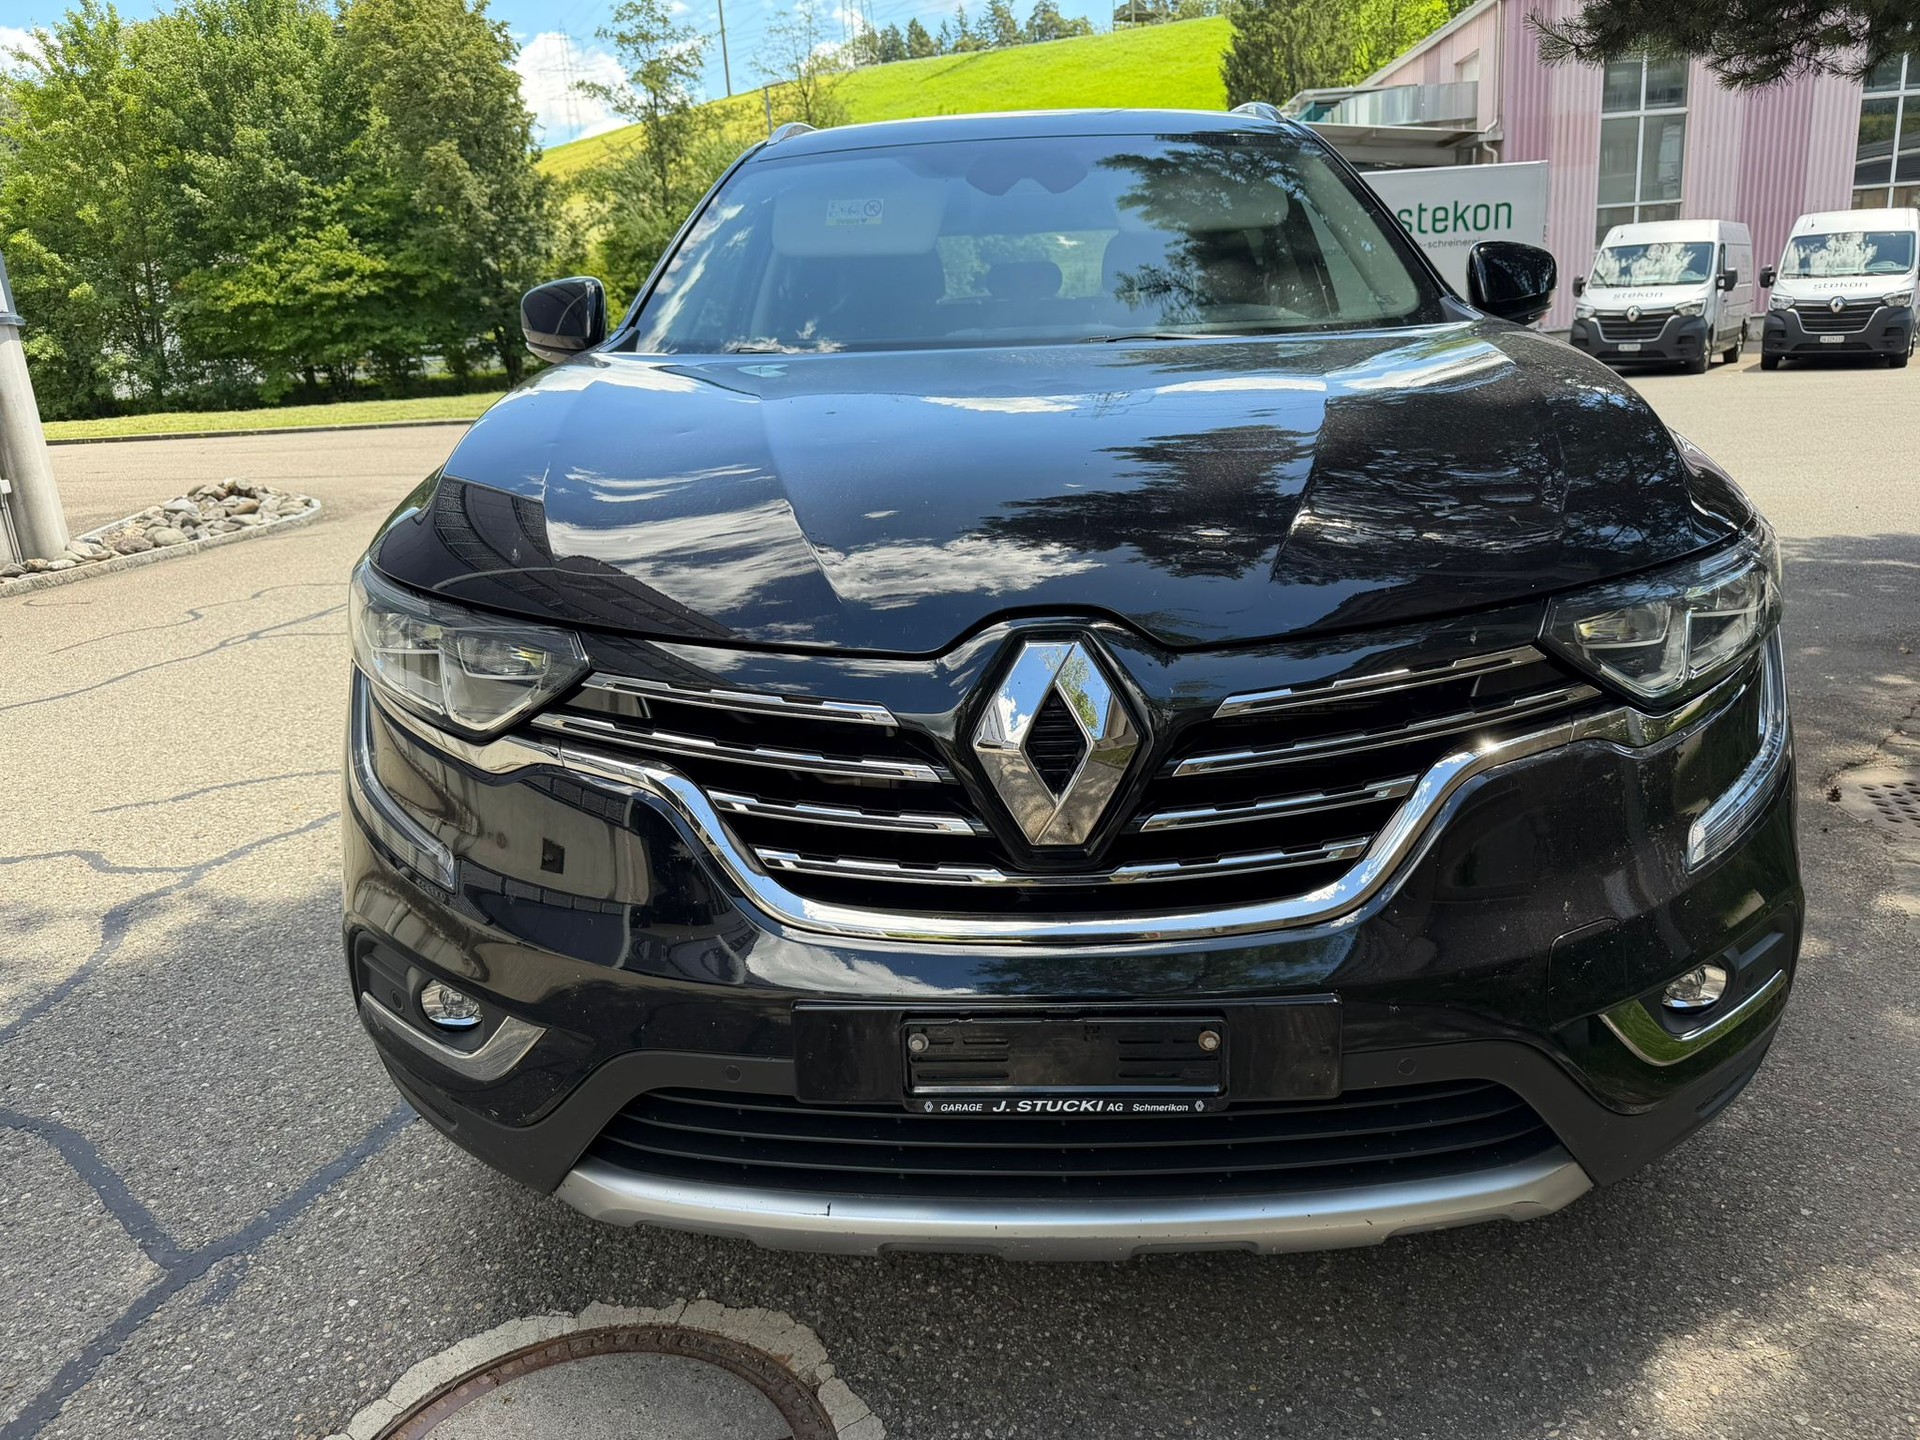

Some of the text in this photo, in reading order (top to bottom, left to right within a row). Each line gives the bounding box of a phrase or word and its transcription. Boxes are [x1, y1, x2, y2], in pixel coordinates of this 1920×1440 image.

[1397, 200, 1512, 234] stekon
[940, 1100, 1189, 1112] GARAGE J. STUCKI AG Schmerikon
